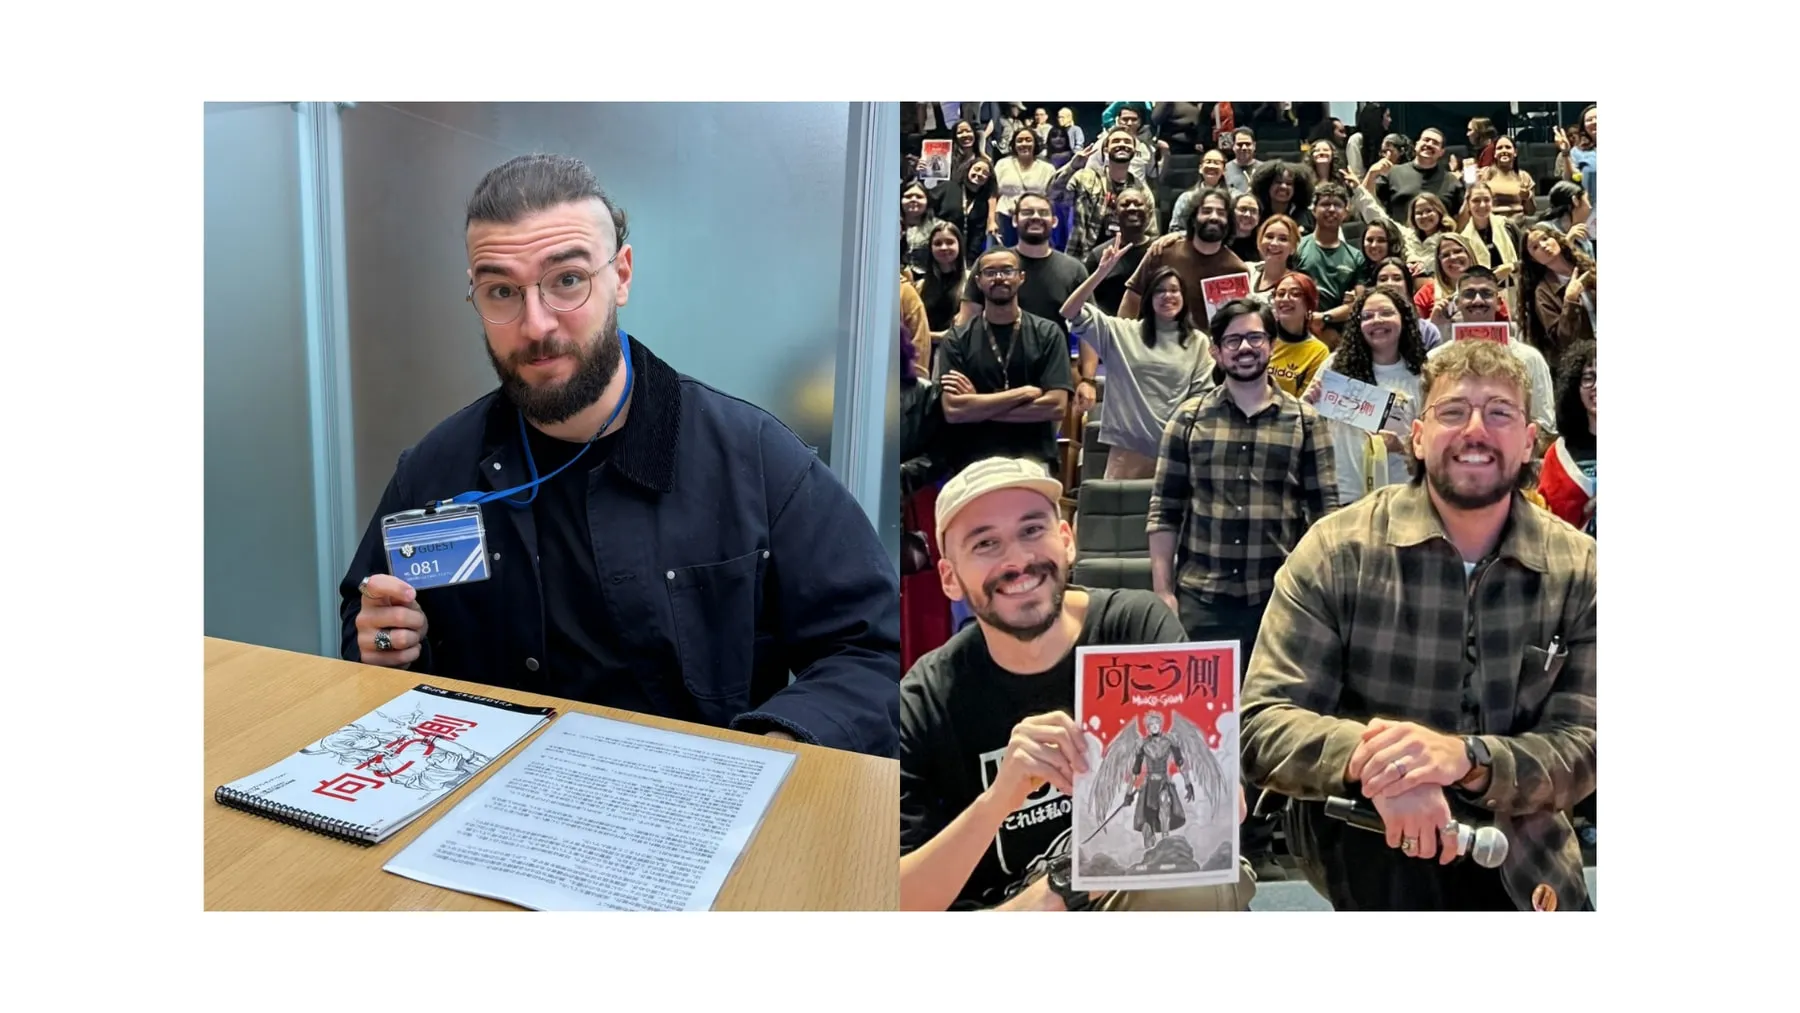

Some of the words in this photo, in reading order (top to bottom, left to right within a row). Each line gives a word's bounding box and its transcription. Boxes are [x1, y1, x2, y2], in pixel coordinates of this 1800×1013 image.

[418, 541, 454, 553] GUEST
[411, 560, 439, 576] 081
[1096, 655, 1220, 705] 向こう側
[312, 714, 478, 802] 向こう側
